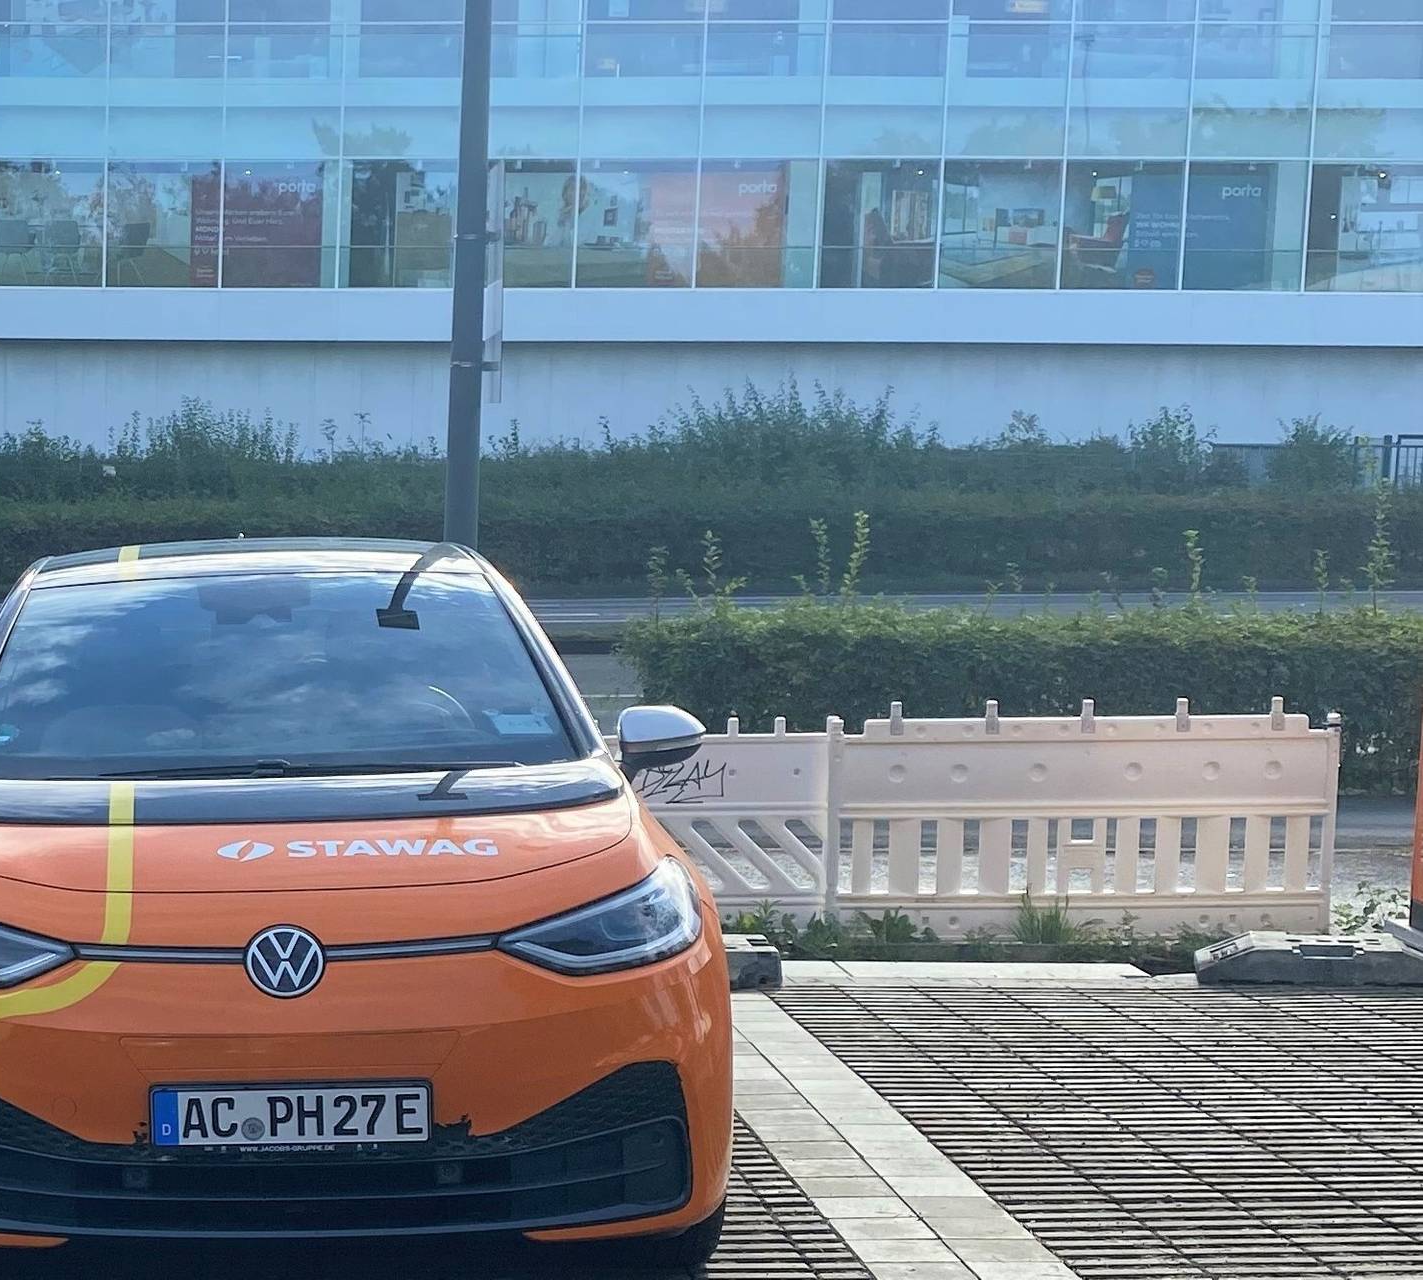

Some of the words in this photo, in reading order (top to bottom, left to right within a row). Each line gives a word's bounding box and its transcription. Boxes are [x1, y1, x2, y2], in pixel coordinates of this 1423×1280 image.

[278, 180, 317, 195] porta
[739, 179, 778, 195] porta
[1222, 184, 1262, 199] porta
[286, 839, 499, 858] STAWAG
[248, 929, 322, 994] VW
[182, 1097, 238, 1139] AC
[161, 1124, 172, 1137] D
